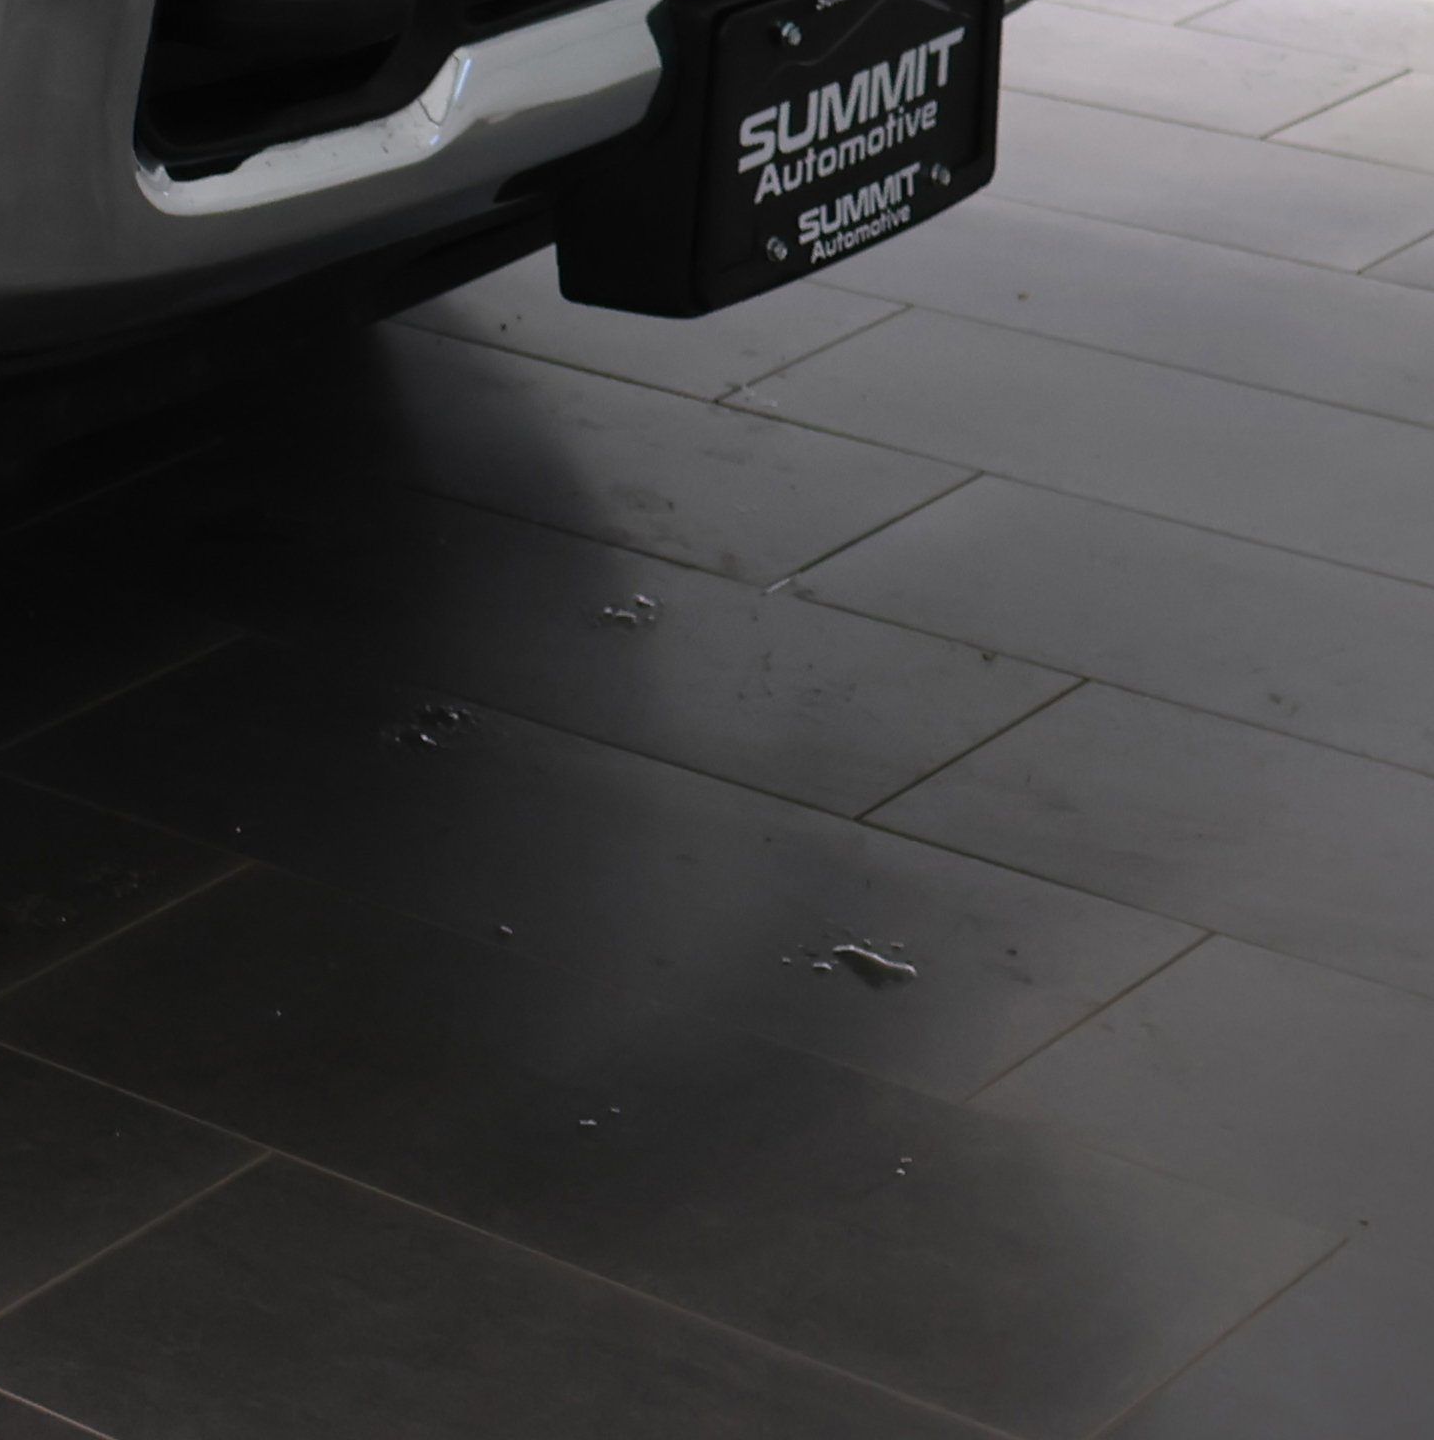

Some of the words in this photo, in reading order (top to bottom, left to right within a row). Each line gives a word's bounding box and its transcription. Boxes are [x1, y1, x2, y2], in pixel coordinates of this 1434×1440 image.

[737, 26, 967, 175] SUMMIT
[753, 99, 940, 206] Automotive
[798, 161, 921, 246] SUMMIT
[810, 204, 912, 265] Automotive
